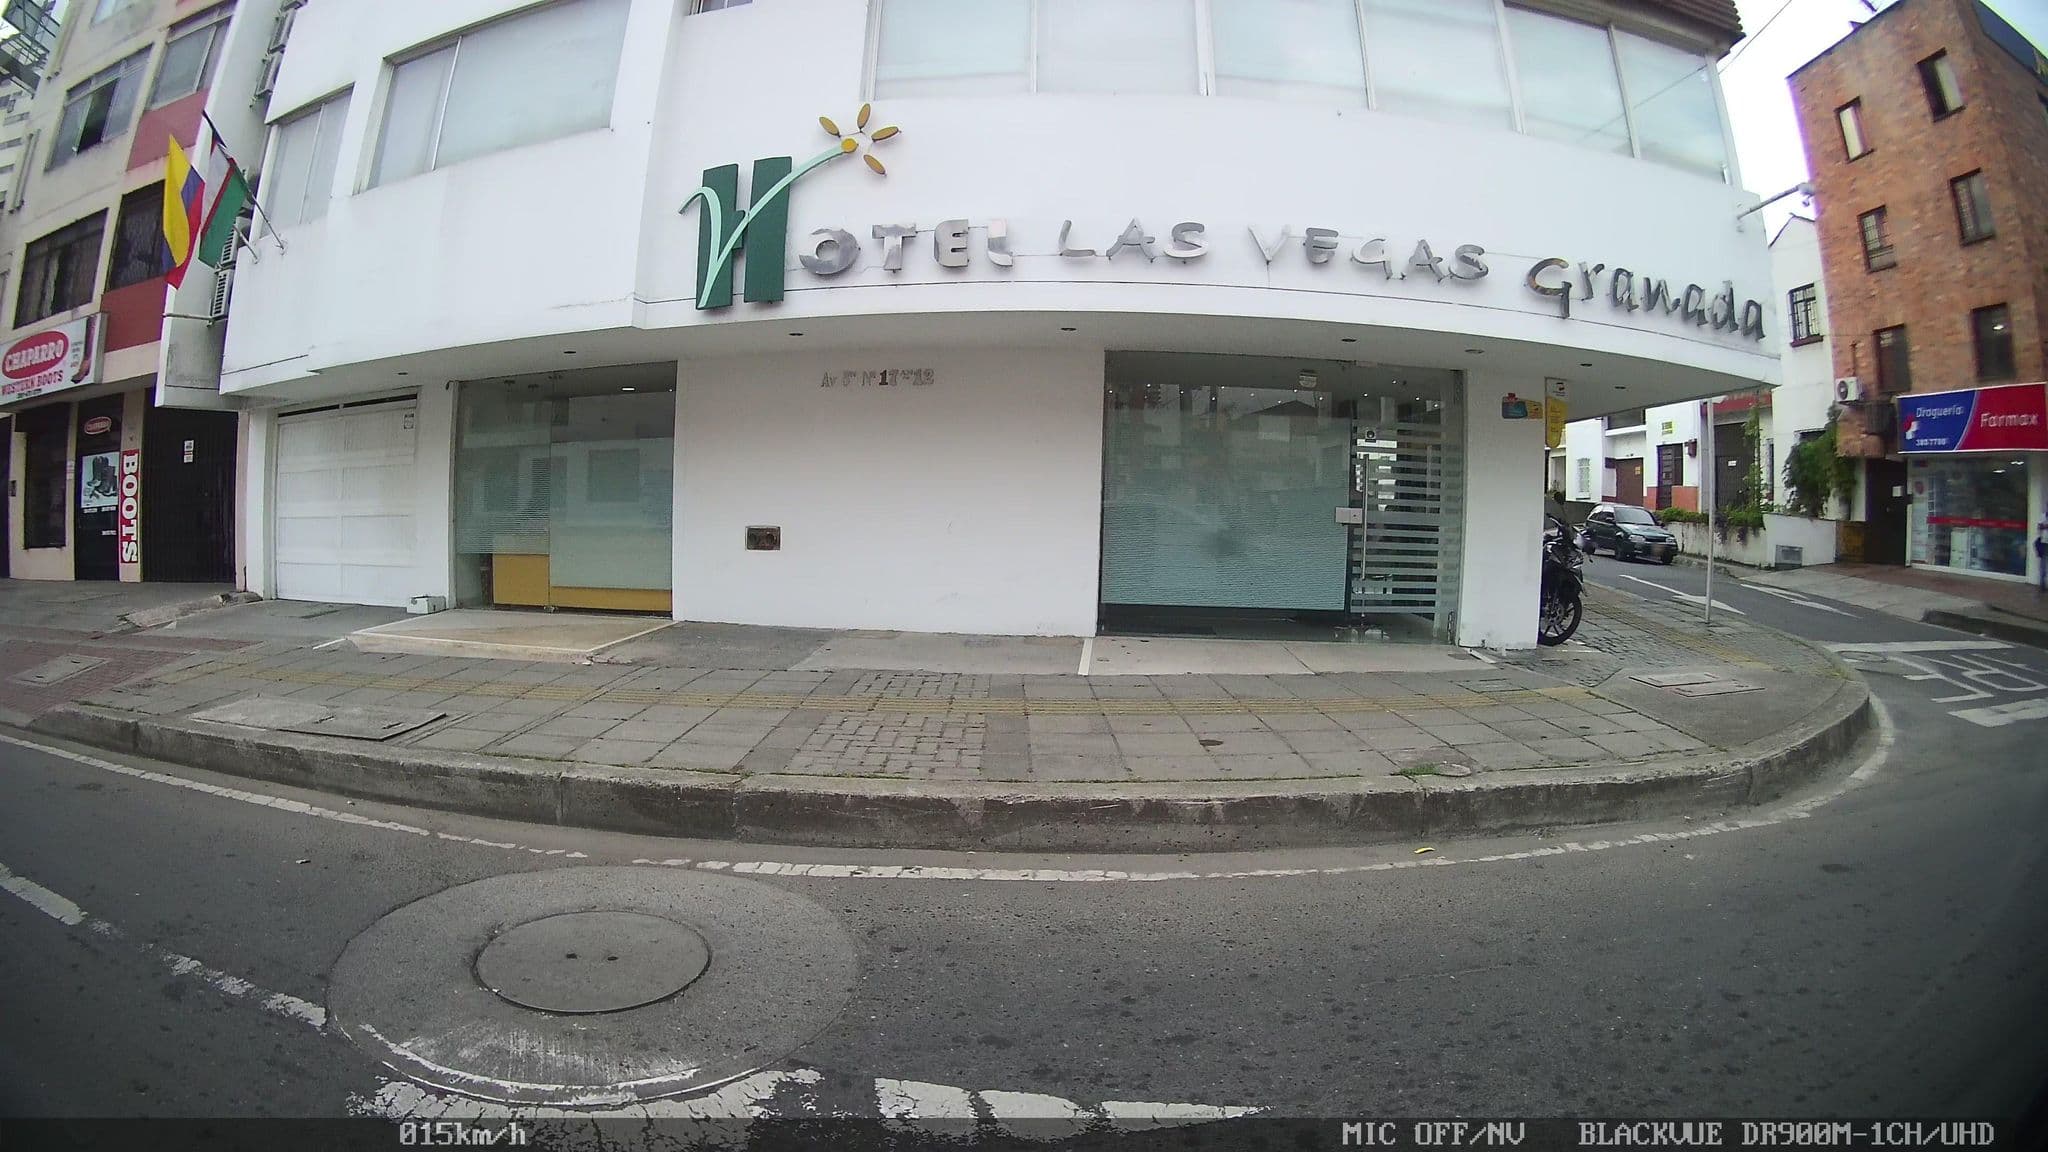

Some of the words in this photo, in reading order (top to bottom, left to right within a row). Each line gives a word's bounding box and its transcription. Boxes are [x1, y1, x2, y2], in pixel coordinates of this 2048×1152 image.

[1060, 217, 1209, 264] LAS
[1248, 224, 1489, 283] VEGAS
[1525, 257, 1767, 342] Granada
[37, 369, 64, 388] BOOTS
[1980, 412, 2039, 429] Farmax
[121, 452, 139, 563] BOOTS
